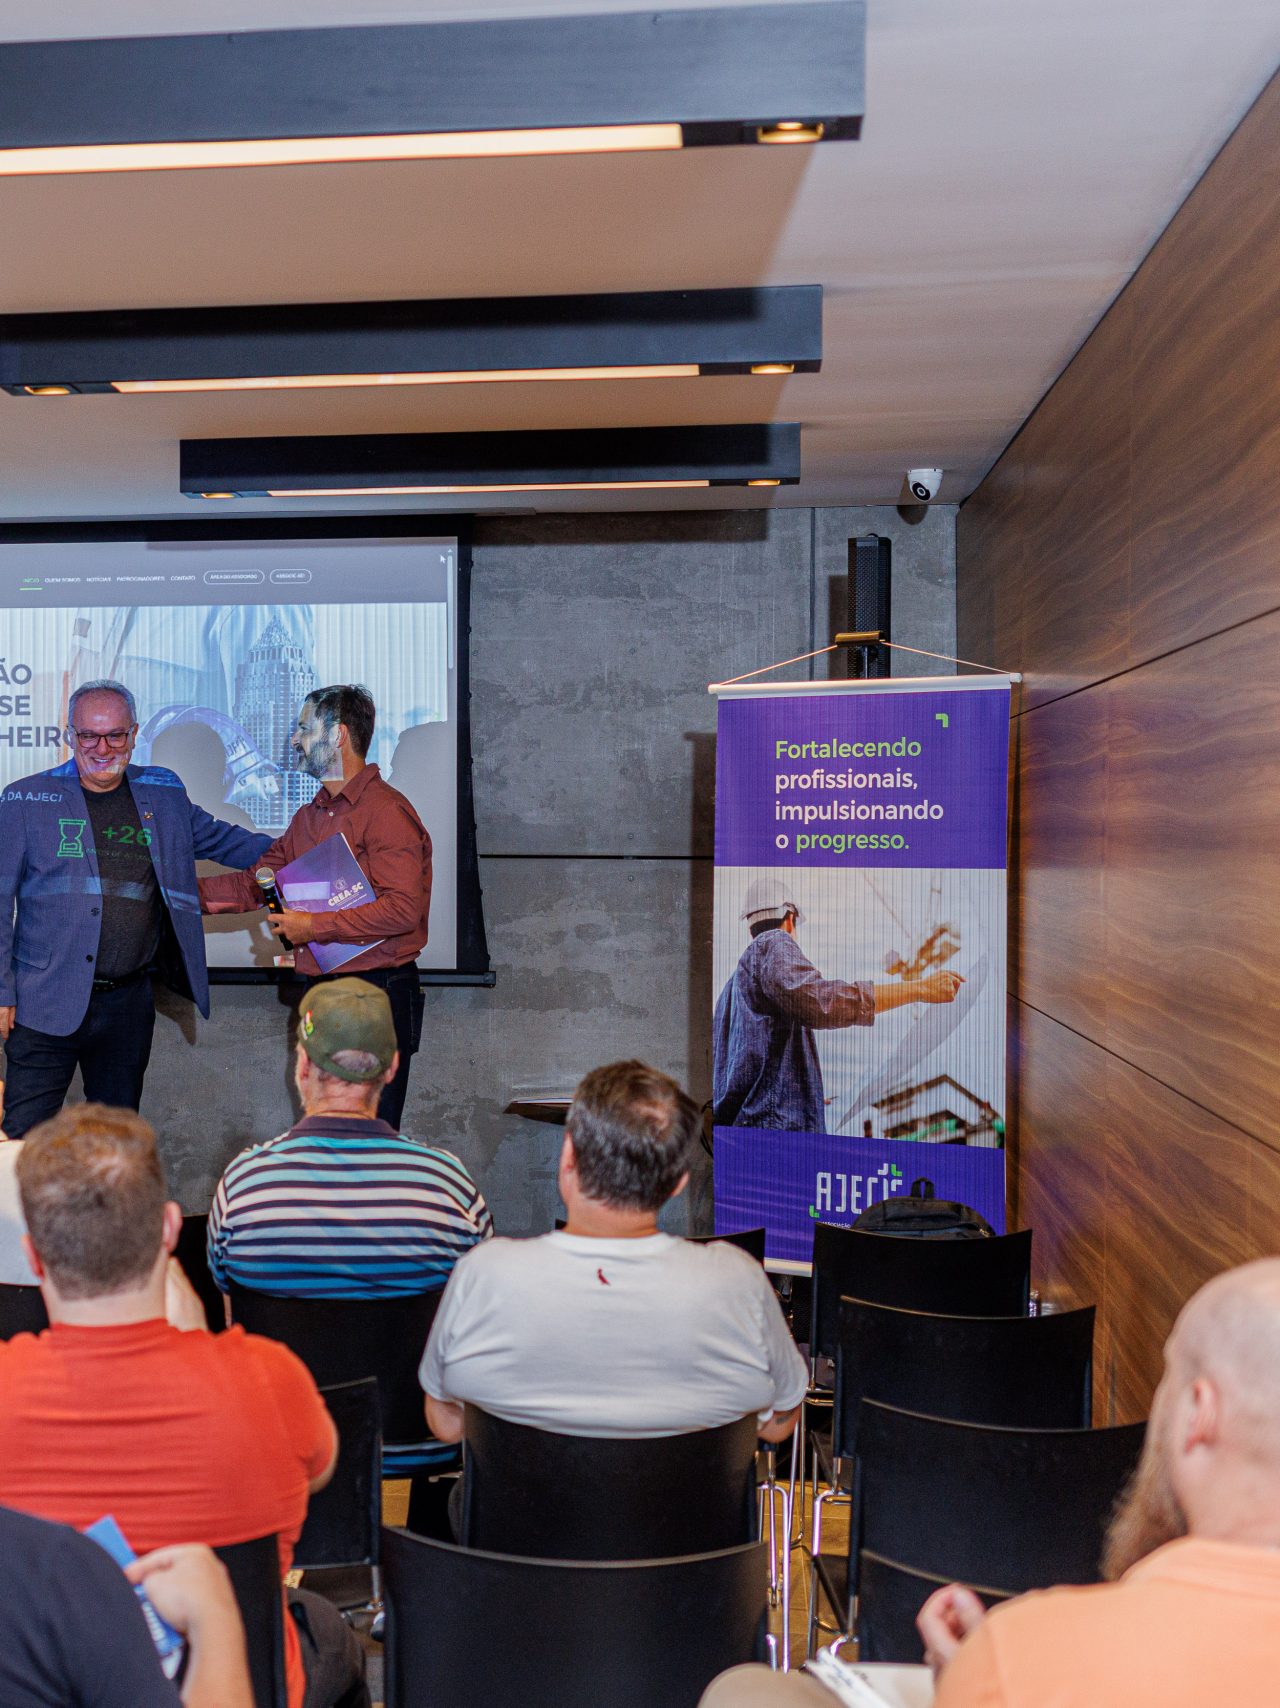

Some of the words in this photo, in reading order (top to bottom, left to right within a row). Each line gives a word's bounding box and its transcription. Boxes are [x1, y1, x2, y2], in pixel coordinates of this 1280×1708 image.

[775, 736, 922, 759] Fortalecendo
[775, 767, 918, 794] profissionais,
[7, 791, 23, 801] DA
[25, 791, 63, 802] AJECI
[775, 799, 944, 825] impulsionando
[102, 825, 153, 847] +26
[775, 834, 789, 849] o
[795, 832, 910, 854] progresso.
